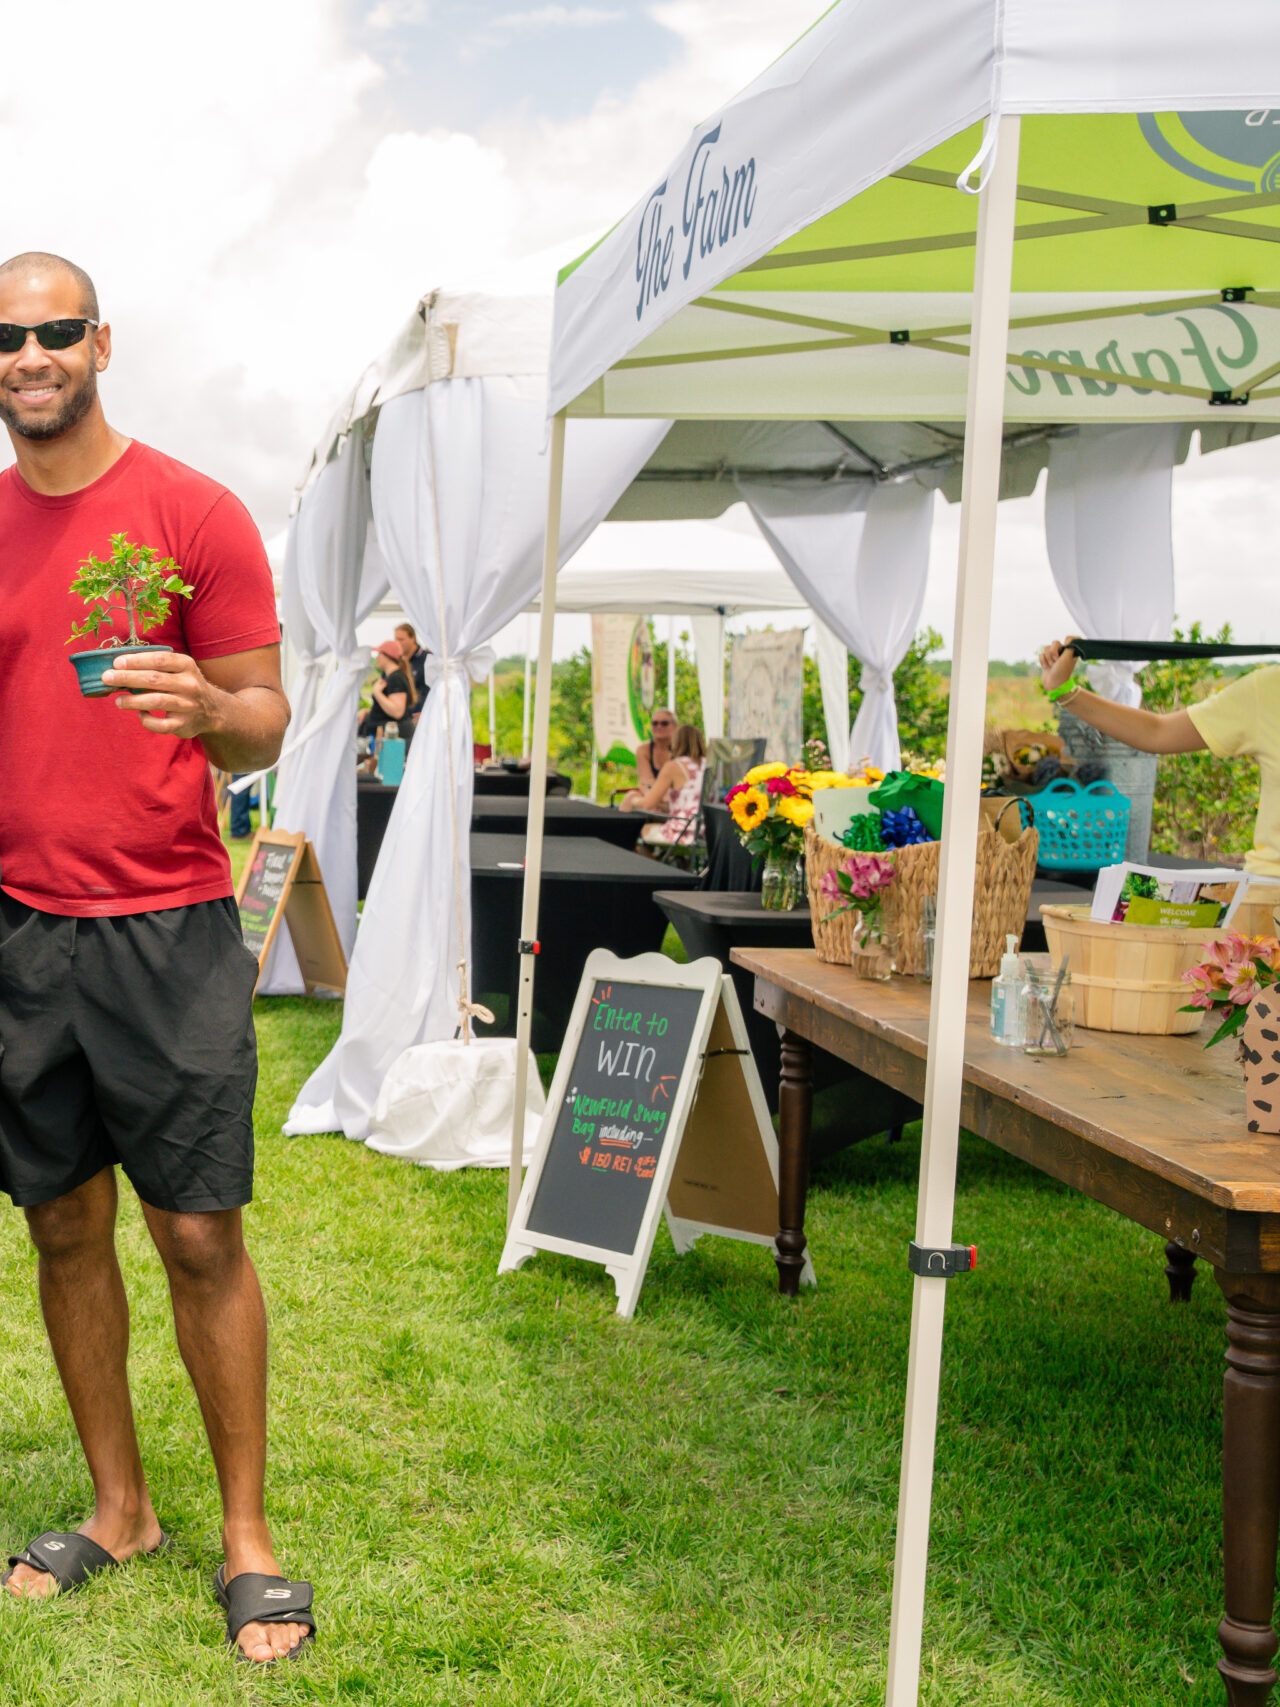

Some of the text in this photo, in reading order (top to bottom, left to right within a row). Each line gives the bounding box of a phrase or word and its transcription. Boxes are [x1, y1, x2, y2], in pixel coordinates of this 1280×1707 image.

[636, 120, 758, 322] The Farm
[1160, 907, 1197, 918] WELCOME
[572, 1117, 596, 1143] Bag
